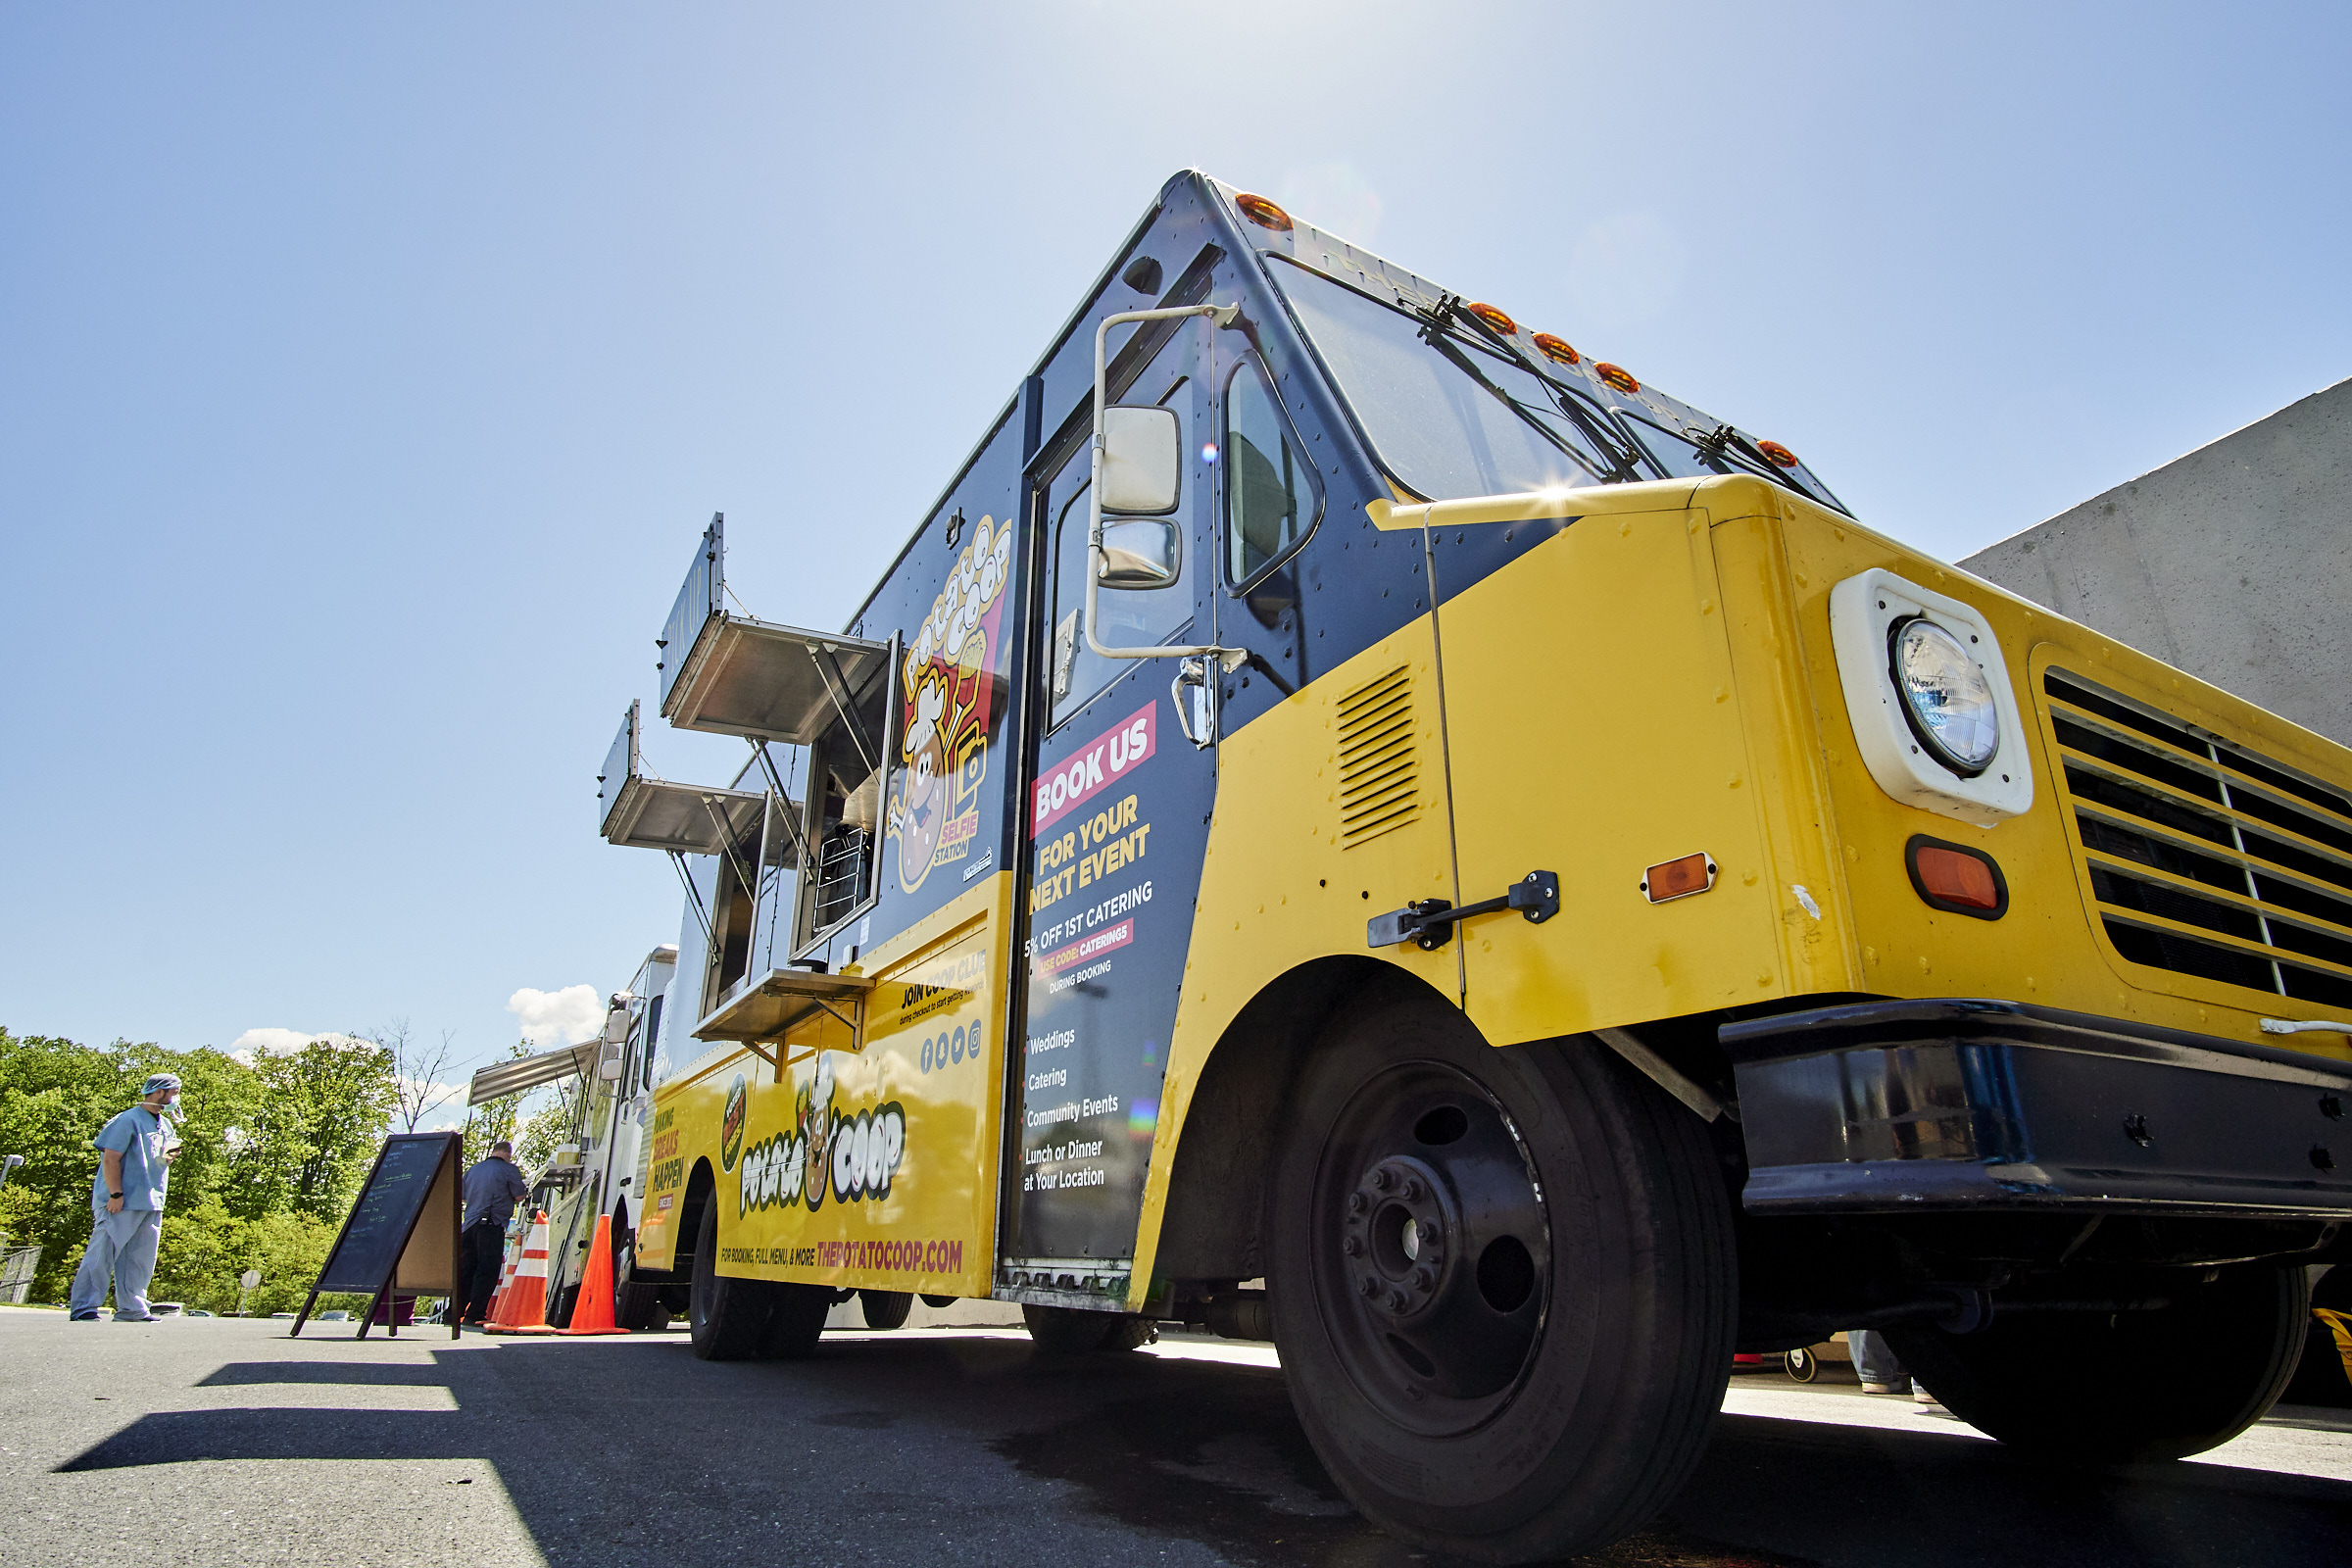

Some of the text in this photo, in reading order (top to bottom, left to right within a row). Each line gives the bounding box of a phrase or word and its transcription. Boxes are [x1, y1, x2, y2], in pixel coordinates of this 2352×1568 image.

[666, 564, 703, 683] PICK UP
[1036, 718, 1148, 822] BOOK US
[941, 813, 978, 845] SELFIE
[1039, 831, 1076, 876] FOR
[1079, 794, 1138, 852] YOUR
[934, 839, 968, 864] STATION
[1029, 864, 1076, 915] NEXT
[1078, 822, 1151, 889] EVENT
[1024, 880, 1153, 958] 5% OFF 1ST CATERING
[1040, 924, 1128, 974] USE CODE: CATERING5
[902, 949, 987, 1009] JOIN COOP CLUB
[1050, 959, 1111, 994] DURING BOOKING
[1030, 1029, 1075, 1055] Weddings
[1029, 1067, 1067, 1092] Catering
[1027, 1094, 1119, 1128] Community Events
[653, 1129, 679, 1162] BREAKS
[1025, 1139, 1103, 1164] Lunch or Dinner
[652, 1156, 685, 1193] HAPPEN
[1024, 1166, 1104, 1192] at Your Location
[720, 1248, 731, 1262] FOR
[755, 1248, 768, 1264] FULL
[789, 1249, 795, 1265] &
[795, 1248, 814, 1266] MORE
[816, 1240, 963, 1273] THEPOTATOCOOP.COM
